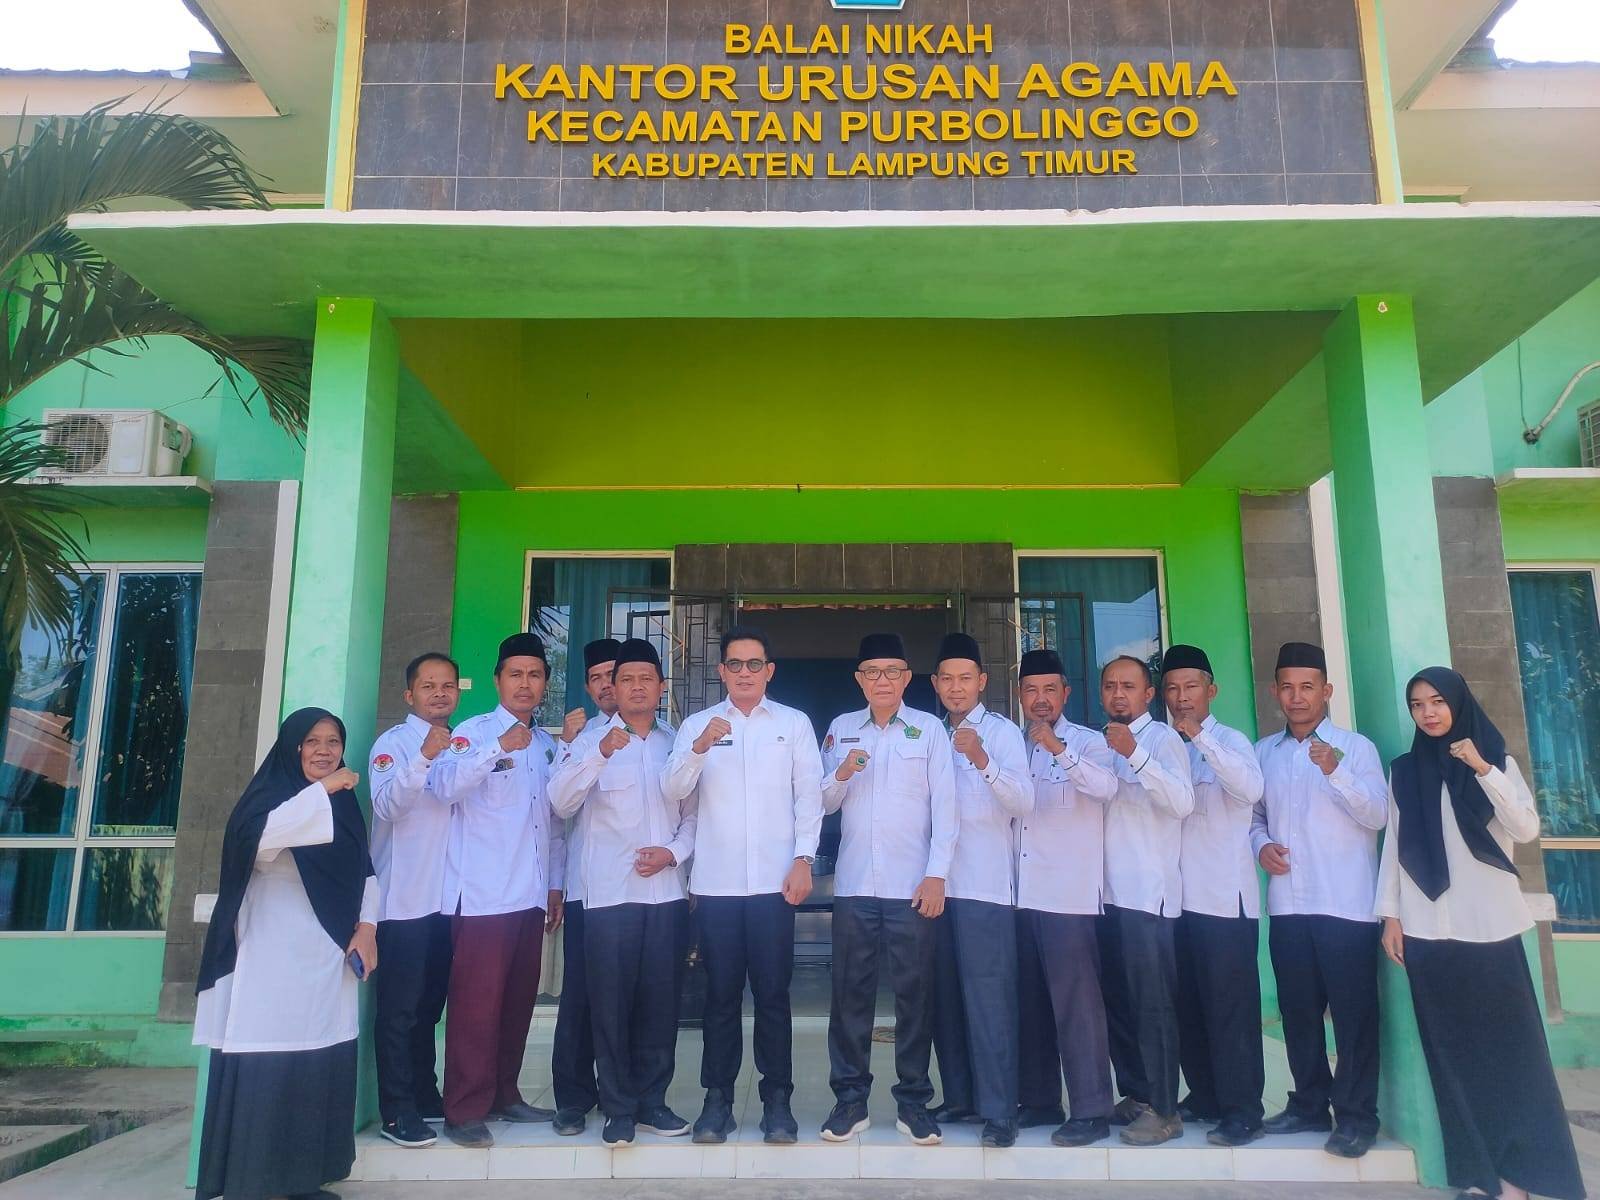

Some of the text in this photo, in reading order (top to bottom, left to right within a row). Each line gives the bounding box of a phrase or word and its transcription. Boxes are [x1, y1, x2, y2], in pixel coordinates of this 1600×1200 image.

[725, 23, 993, 53] BALAI NIKAH
[495, 61, 1238, 100] KANTOR URUSAN AGAMA
[528, 106, 1199, 142] KECAMATAN PURBOLINGGO
[592, 149, 1137, 176] KABUPATEN LAMPUNG TIMUR
